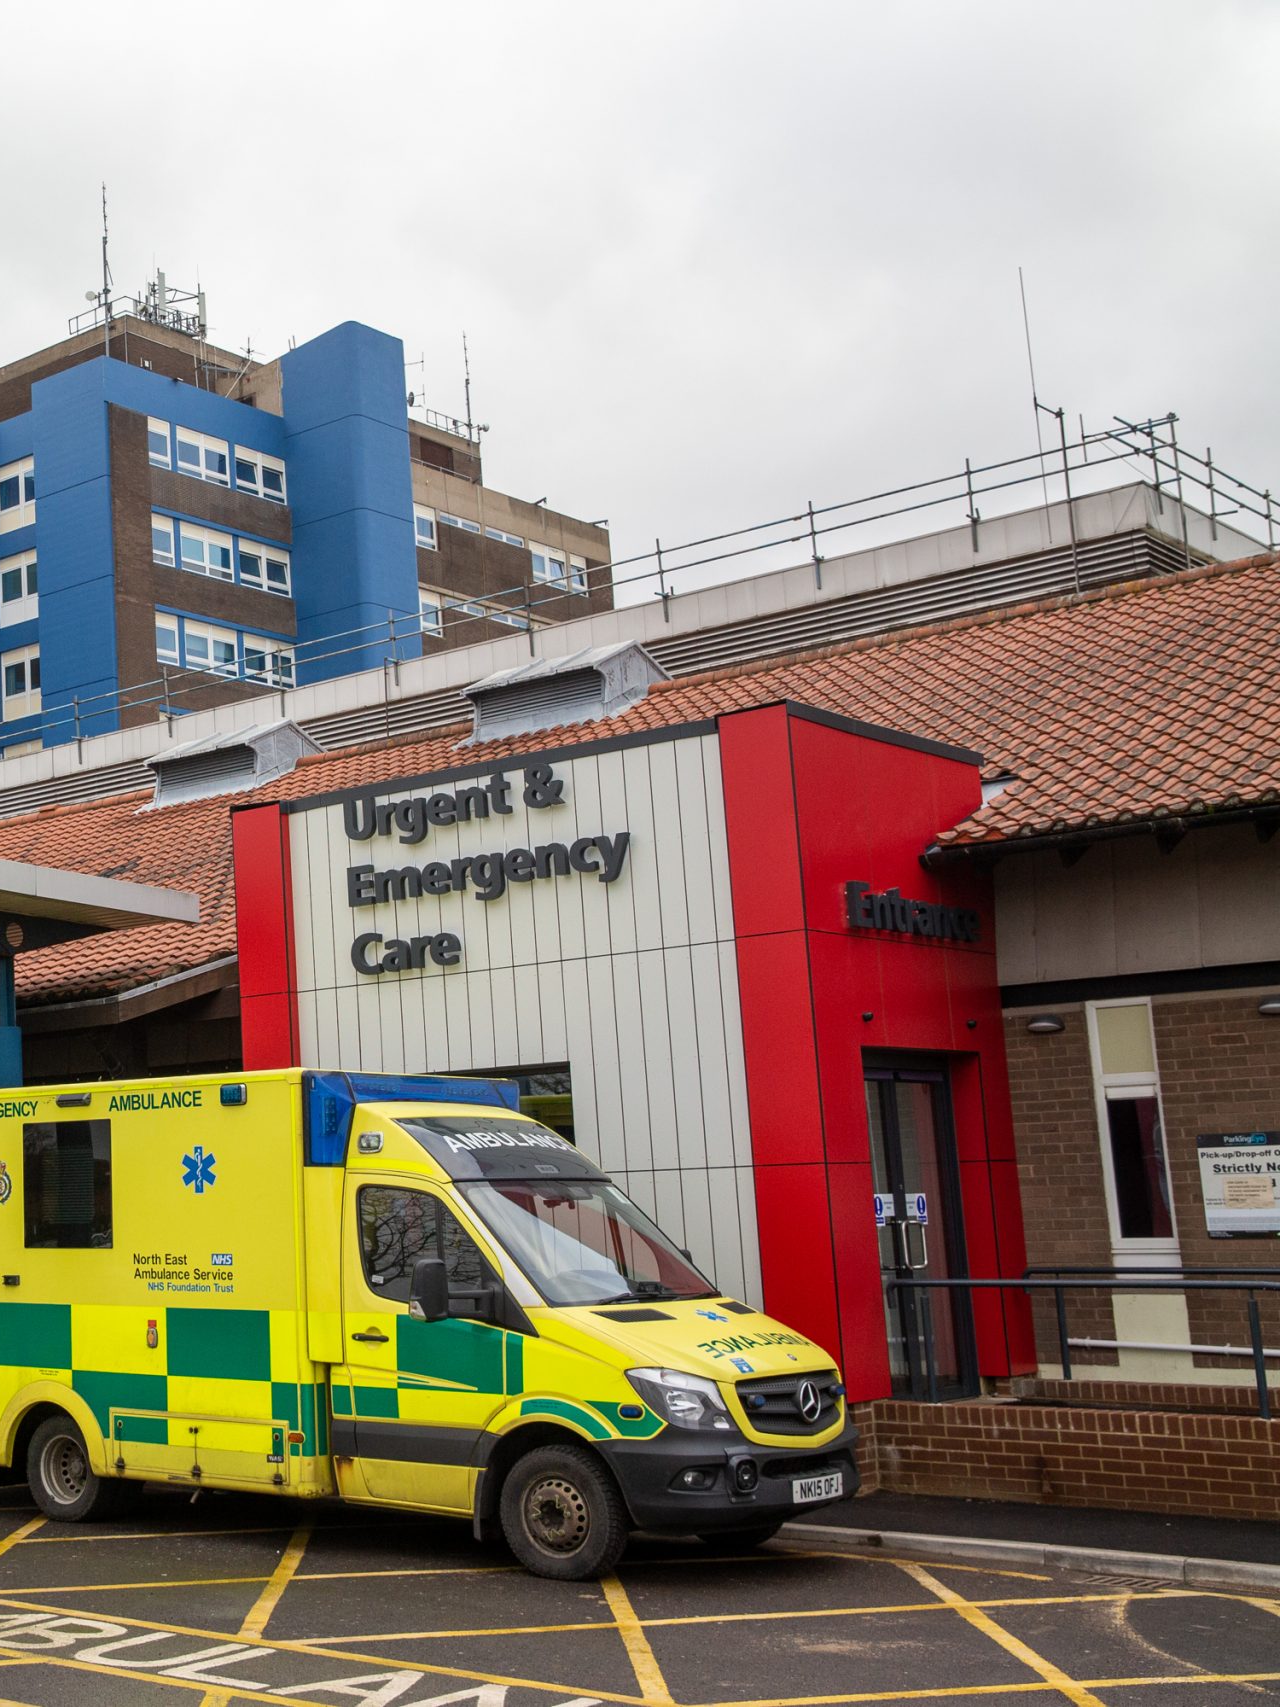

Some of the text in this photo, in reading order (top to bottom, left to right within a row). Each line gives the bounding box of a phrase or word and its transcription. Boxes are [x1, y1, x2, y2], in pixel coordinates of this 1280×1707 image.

[342, 763, 566, 844] Urgent &
[347, 832, 630, 908] Emergency
[845, 880, 981, 942] Entrance
[350, 932, 462, 975] Care
[109, 1090, 202, 1112] AMBULANCE
[1213, 1162, 1262, 1173] Strictly
[133, 1253, 188, 1265] North East
[212, 1254, 232, 1265] NHS
[134, 1268, 233, 1280] Ambulance Service
[148, 1282, 234, 1293] NHS Foundation Trust
[800, 1476, 839, 1499] NK15 OFJ
